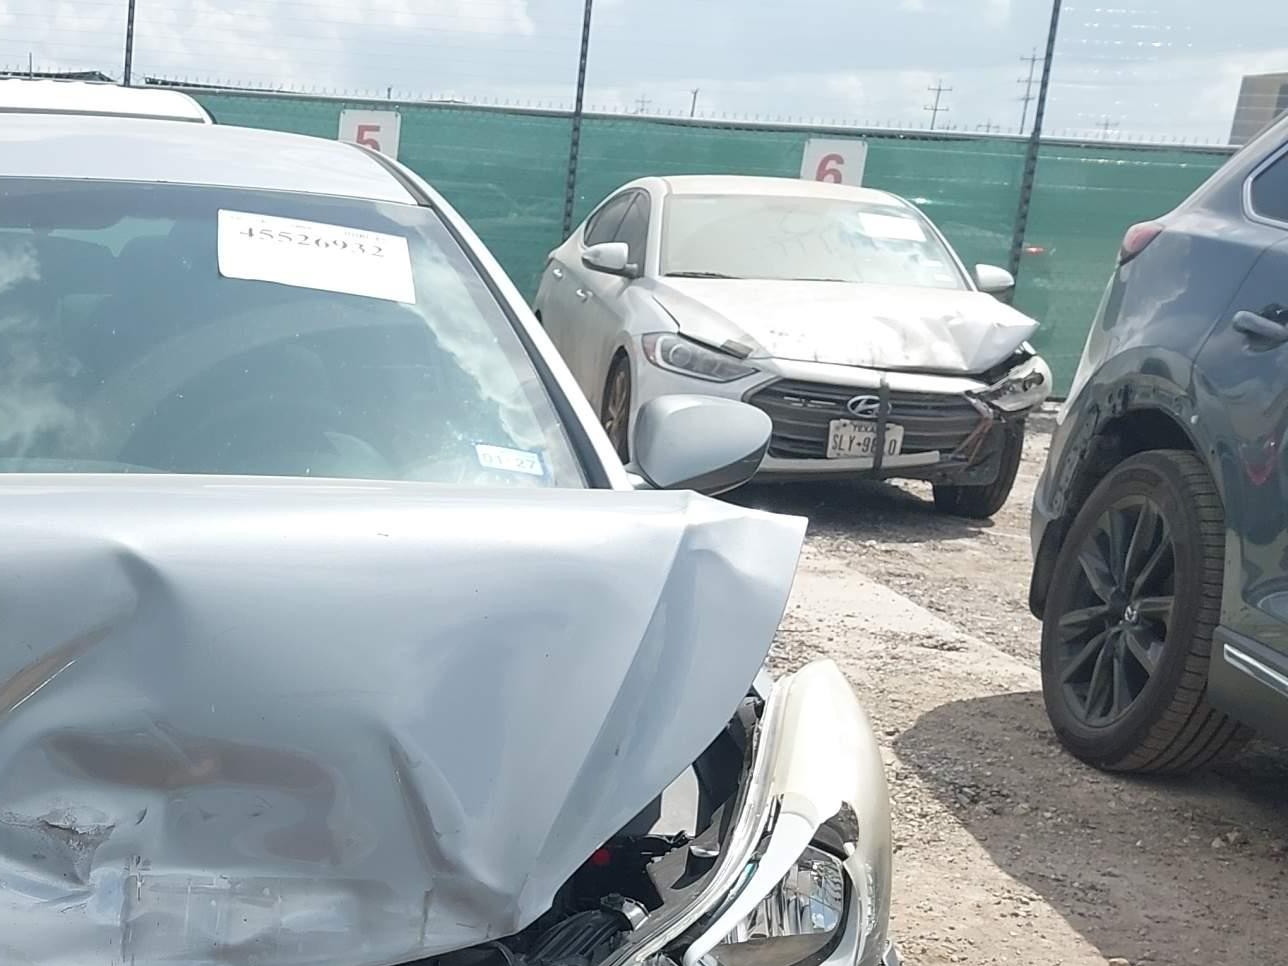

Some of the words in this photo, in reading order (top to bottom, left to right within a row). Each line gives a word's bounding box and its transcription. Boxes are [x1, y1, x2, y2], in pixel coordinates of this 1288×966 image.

[355, 125, 381, 151] 5
[815, 153, 845, 184] 6
[239, 226, 385, 260] 45526932
